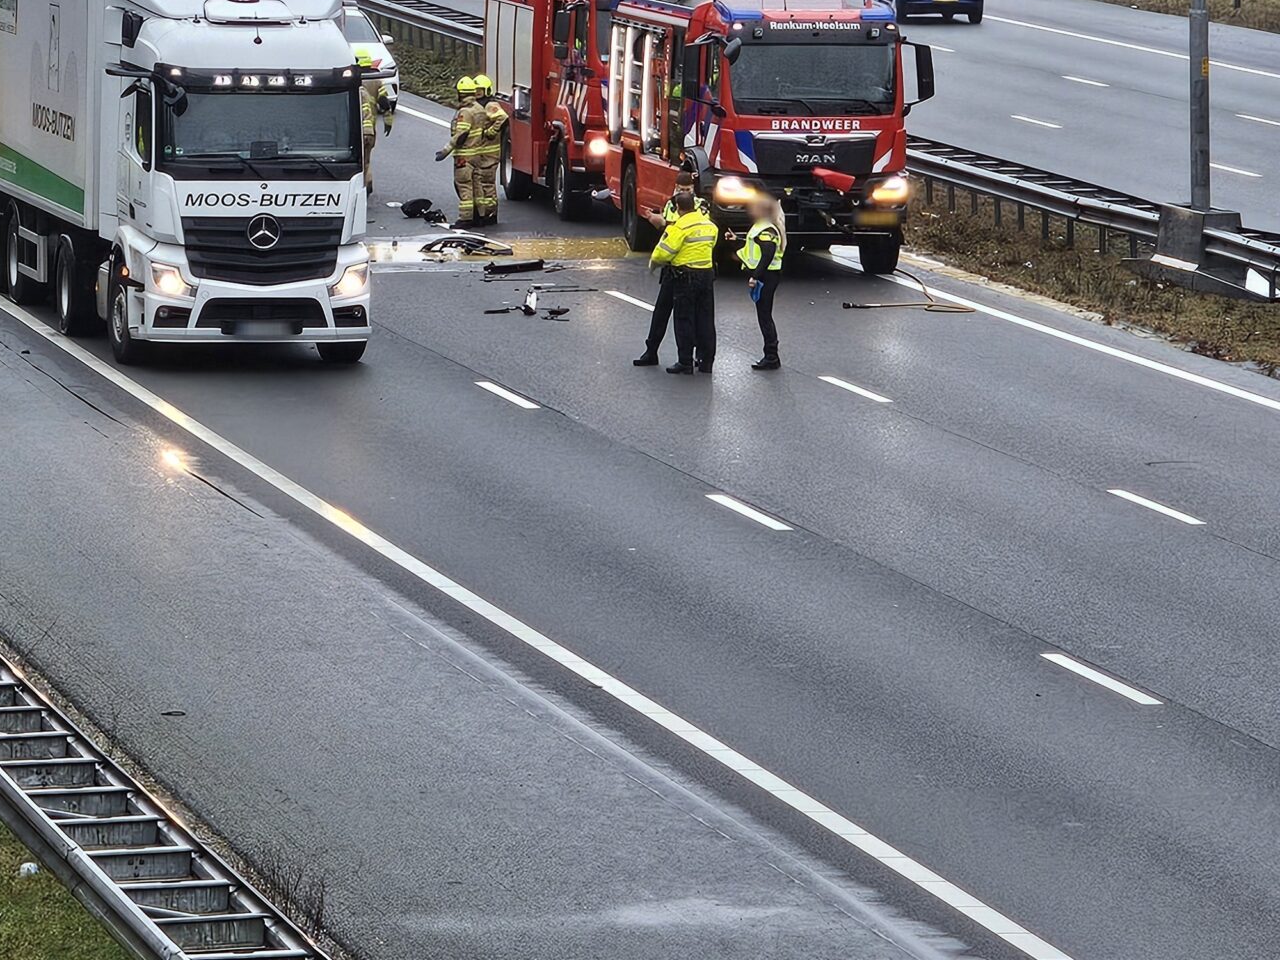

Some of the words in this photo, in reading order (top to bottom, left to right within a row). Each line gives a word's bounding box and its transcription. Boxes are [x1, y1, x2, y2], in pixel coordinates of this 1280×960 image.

[32, 101, 76, 142] MOOS-BUTZEN
[771, 119, 861, 130] BRANDWEER
[795, 154, 836, 163] MAN
[185, 192, 341, 207] MOOS-BUTZEN
